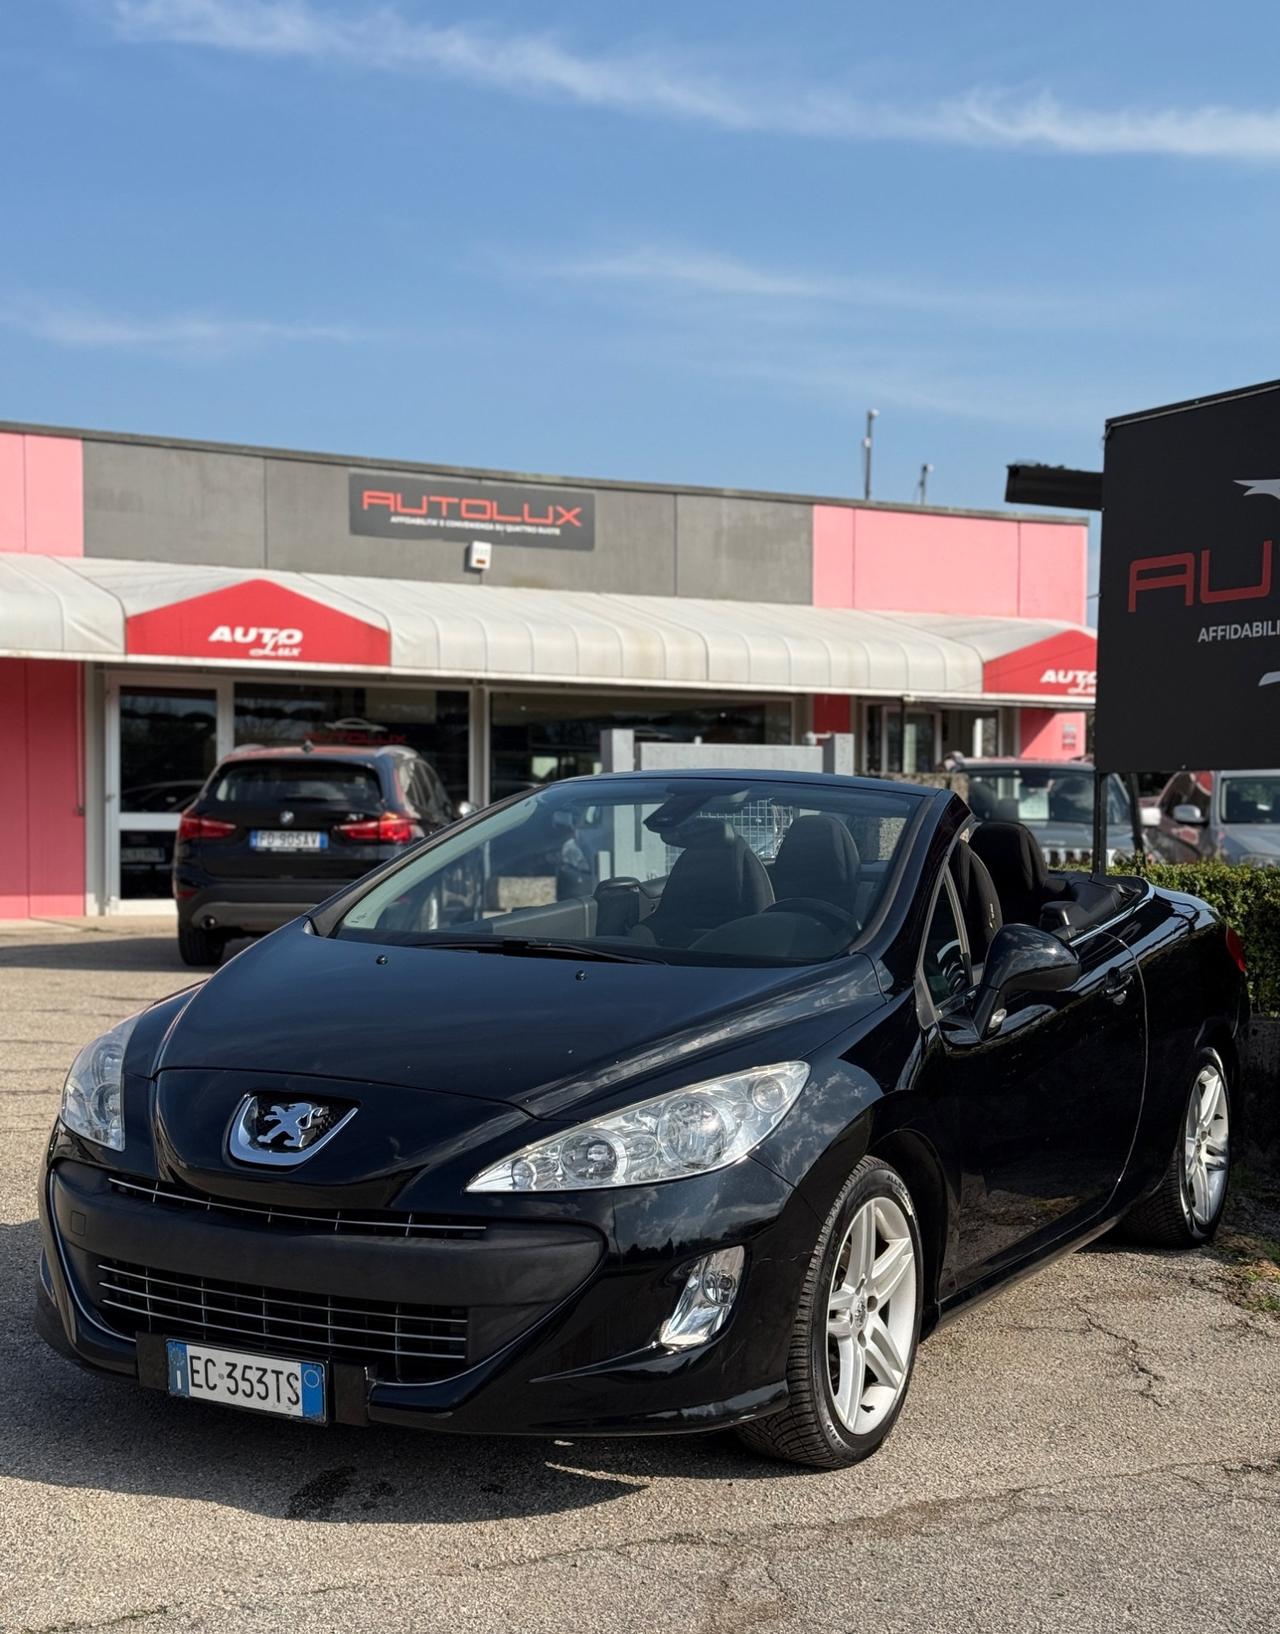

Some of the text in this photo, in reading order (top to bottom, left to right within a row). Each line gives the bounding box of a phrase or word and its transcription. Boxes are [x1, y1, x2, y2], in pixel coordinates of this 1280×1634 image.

[362, 489, 582, 527] AUTOLUX
[208, 625, 304, 646] AUTO
[189, 1355, 300, 1406] EC 353TS
